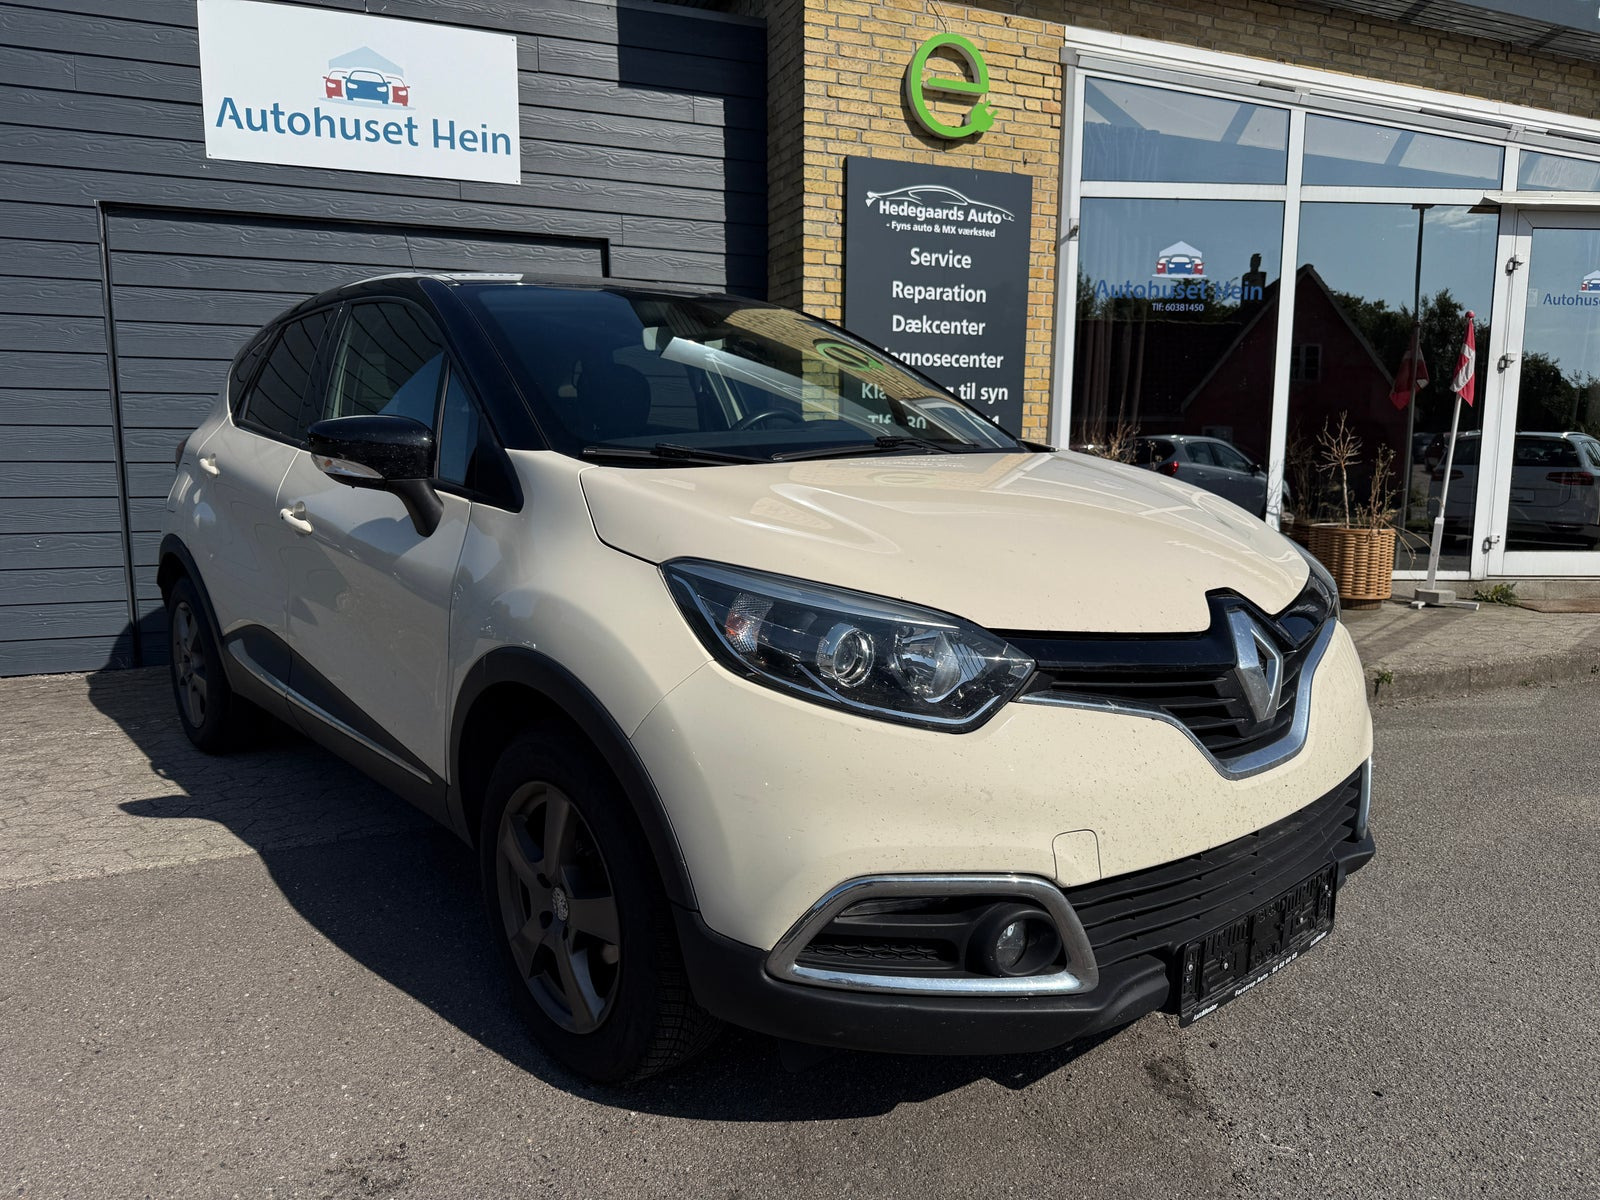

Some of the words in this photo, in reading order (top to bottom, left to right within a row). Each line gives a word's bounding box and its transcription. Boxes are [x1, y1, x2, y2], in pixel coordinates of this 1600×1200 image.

[215, 96, 419, 147] Autohuset
[432, 118, 511, 155] Hein
[879, 200, 965, 221] Hedegaards
[967, 208, 1002, 225] Auto
[891, 220, 911, 232] Fyns
[912, 222, 932, 232] auto
[933, 223, 941, 233] &
[942, 225, 956, 235] MX
[958, 226, 996, 238] værksted
[910, 247, 972, 269] Service
[892, 281, 987, 304] Reparation
[1095, 280, 1207, 300] Autohuset
[1214, 280, 1263, 301] Hein
[1543, 293, 1600, 306] Autohus
[1165, 303, 1204, 312] 60381450
[892, 315, 986, 336] Dækcenter
[958, 382, 976, 400] til
[980, 387, 1009, 405] syn
